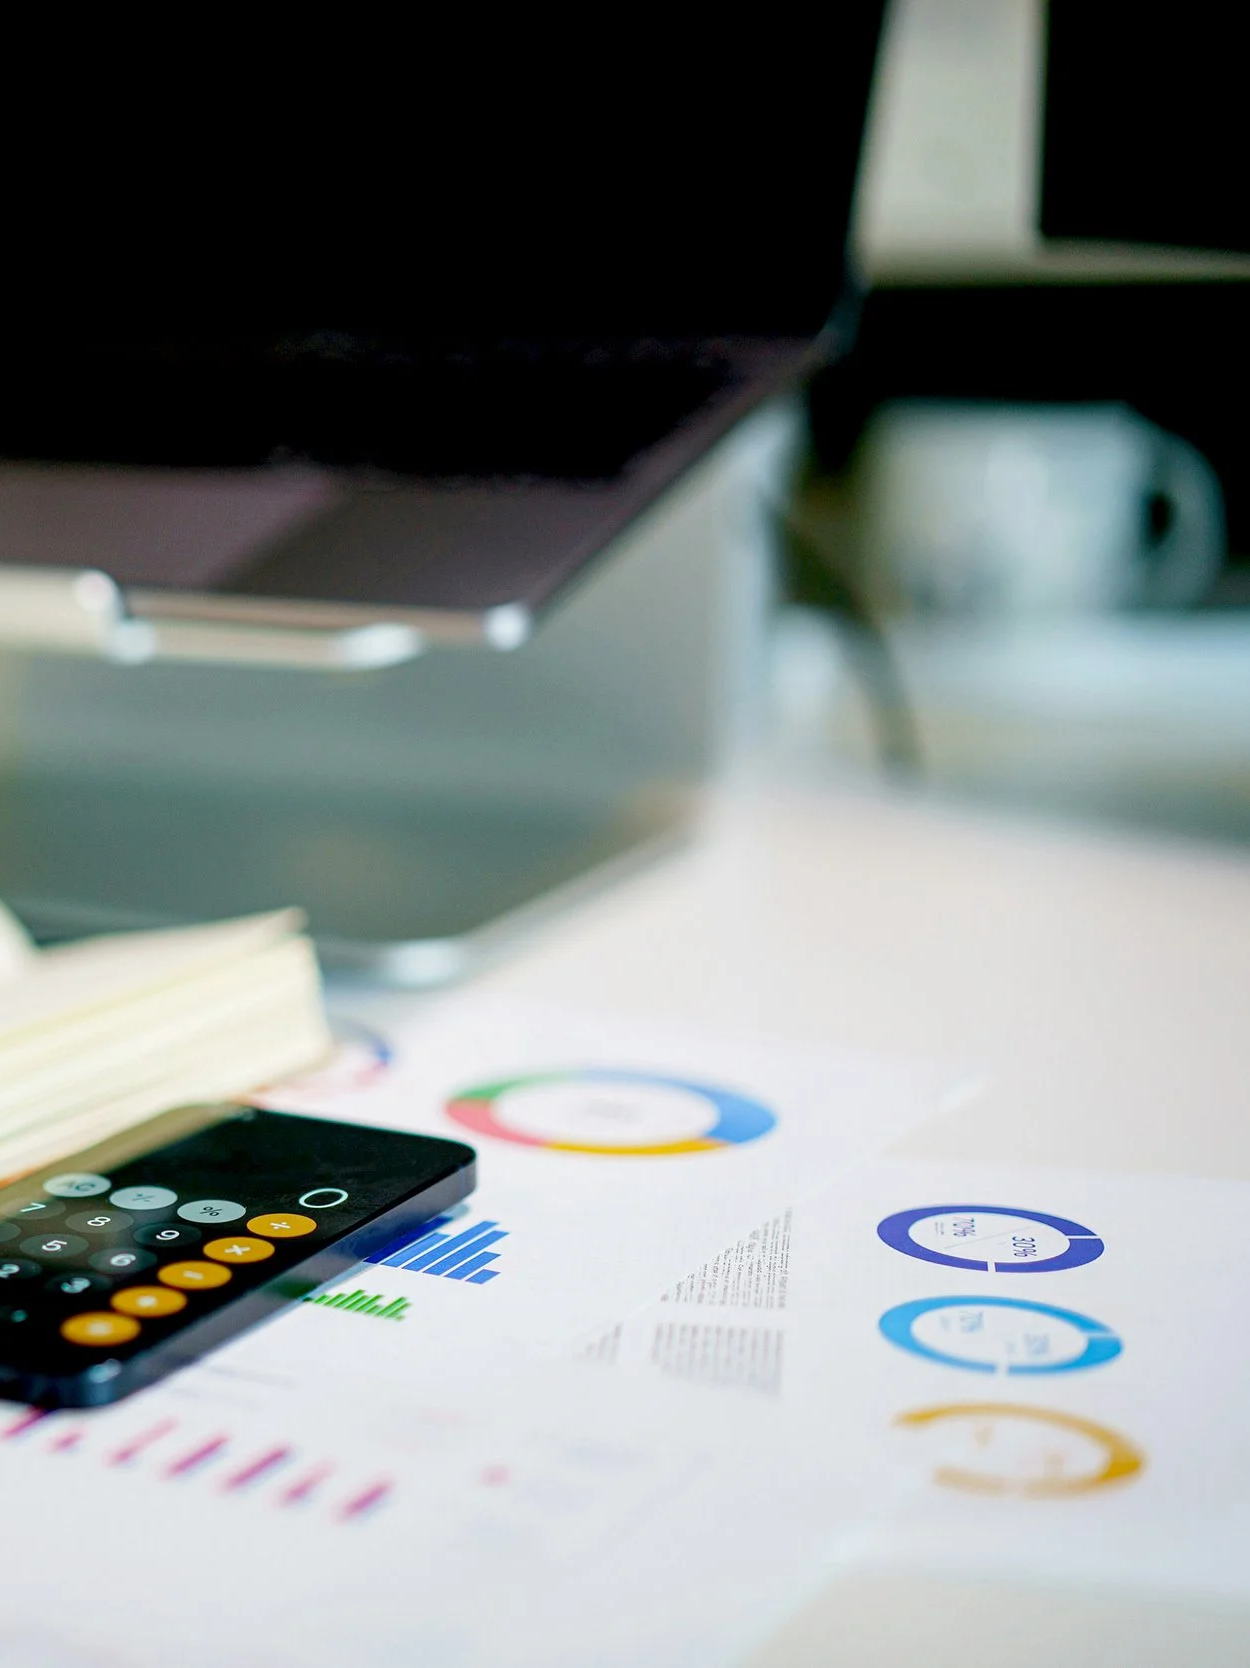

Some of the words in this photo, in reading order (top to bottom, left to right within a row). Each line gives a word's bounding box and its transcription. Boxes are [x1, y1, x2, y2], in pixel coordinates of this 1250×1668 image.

[299, 1187, 349, 1209] 0
[20, 1202, 46, 1213] 7
[86, 1216, 111, 1227] 8
[155, 1229, 180, 1241] 9
[41, 1240, 68, 1251] 5
[1012, 1236, 1037, 1257] 30%
[109, 1253, 137, 1267] 6
[60, 1277, 91, 1294] 3
